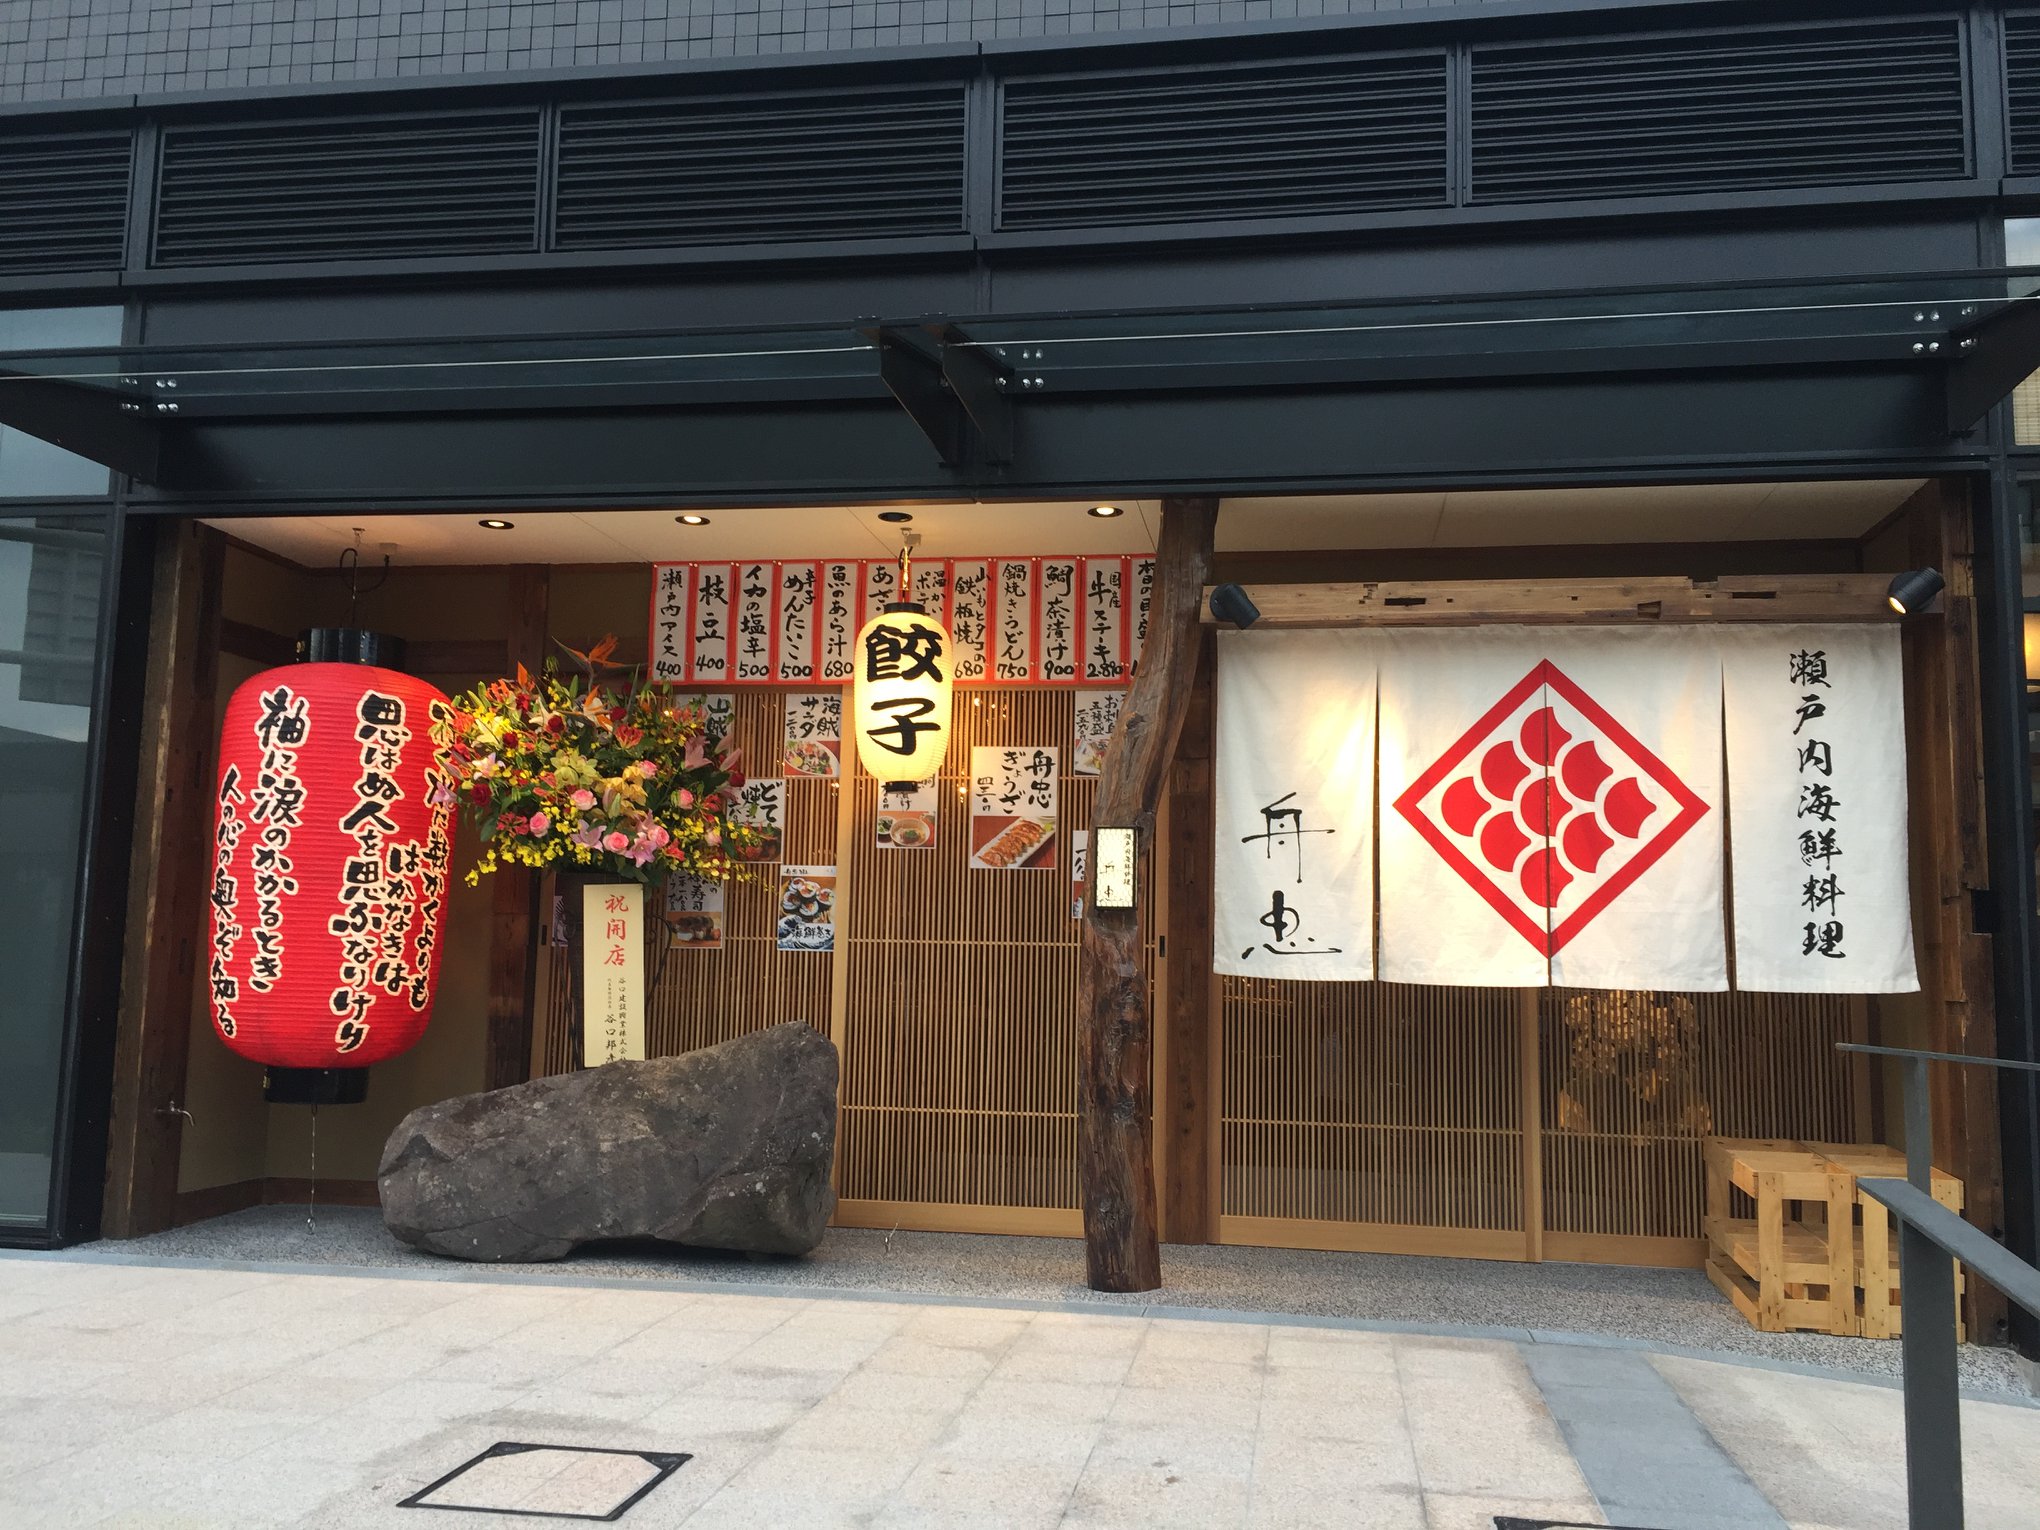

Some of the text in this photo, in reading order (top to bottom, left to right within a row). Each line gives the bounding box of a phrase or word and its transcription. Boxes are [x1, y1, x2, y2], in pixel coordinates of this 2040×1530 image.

[660, 568, 683, 657] 瀬戸内アイス
[695, 574, 729, 643] 枝豆
[740, 565, 768, 658] イカの塩辛
[803, 568, 816, 605] 辛子
[827, 565, 851, 657] 魚のあら汁
[1001, 563, 1027, 661] 鍋焼きうどん
[1044, 565, 1074, 661] 鯛茶漬け
[1088, 570, 1112, 663] 牛ステーキ
[1109, 571, 1122, 608] 国産
[783, 574, 805, 661] めんたいこ
[656, 660, 681, 676] 400
[696, 654, 725, 672] 400
[739, 660, 770, 678] 500
[781, 661, 813, 679] 500
[825, 660, 854, 678] 680
[865, 623, 943, 756] 餃子
[954, 660, 984, 678] 680
[997, 662, 1028, 679] 750
[1044, 660, 1075, 680] 900
[799, 696, 819, 739] サラダ
[816, 695, 842, 738] 海賊
[760, 781, 783, 823] どて
[998, 750, 1026, 814] ぎょうざ
[1025, 750, 1056, 809] 舟忠
[1790, 648, 1847, 959] 瀬戸内海鮮料理
[250, 686, 307, 991] 袖に涙のかかるとき
[1241, 791, 1343, 960] 舟忠
[604, 894, 629, 967] 祝開店
